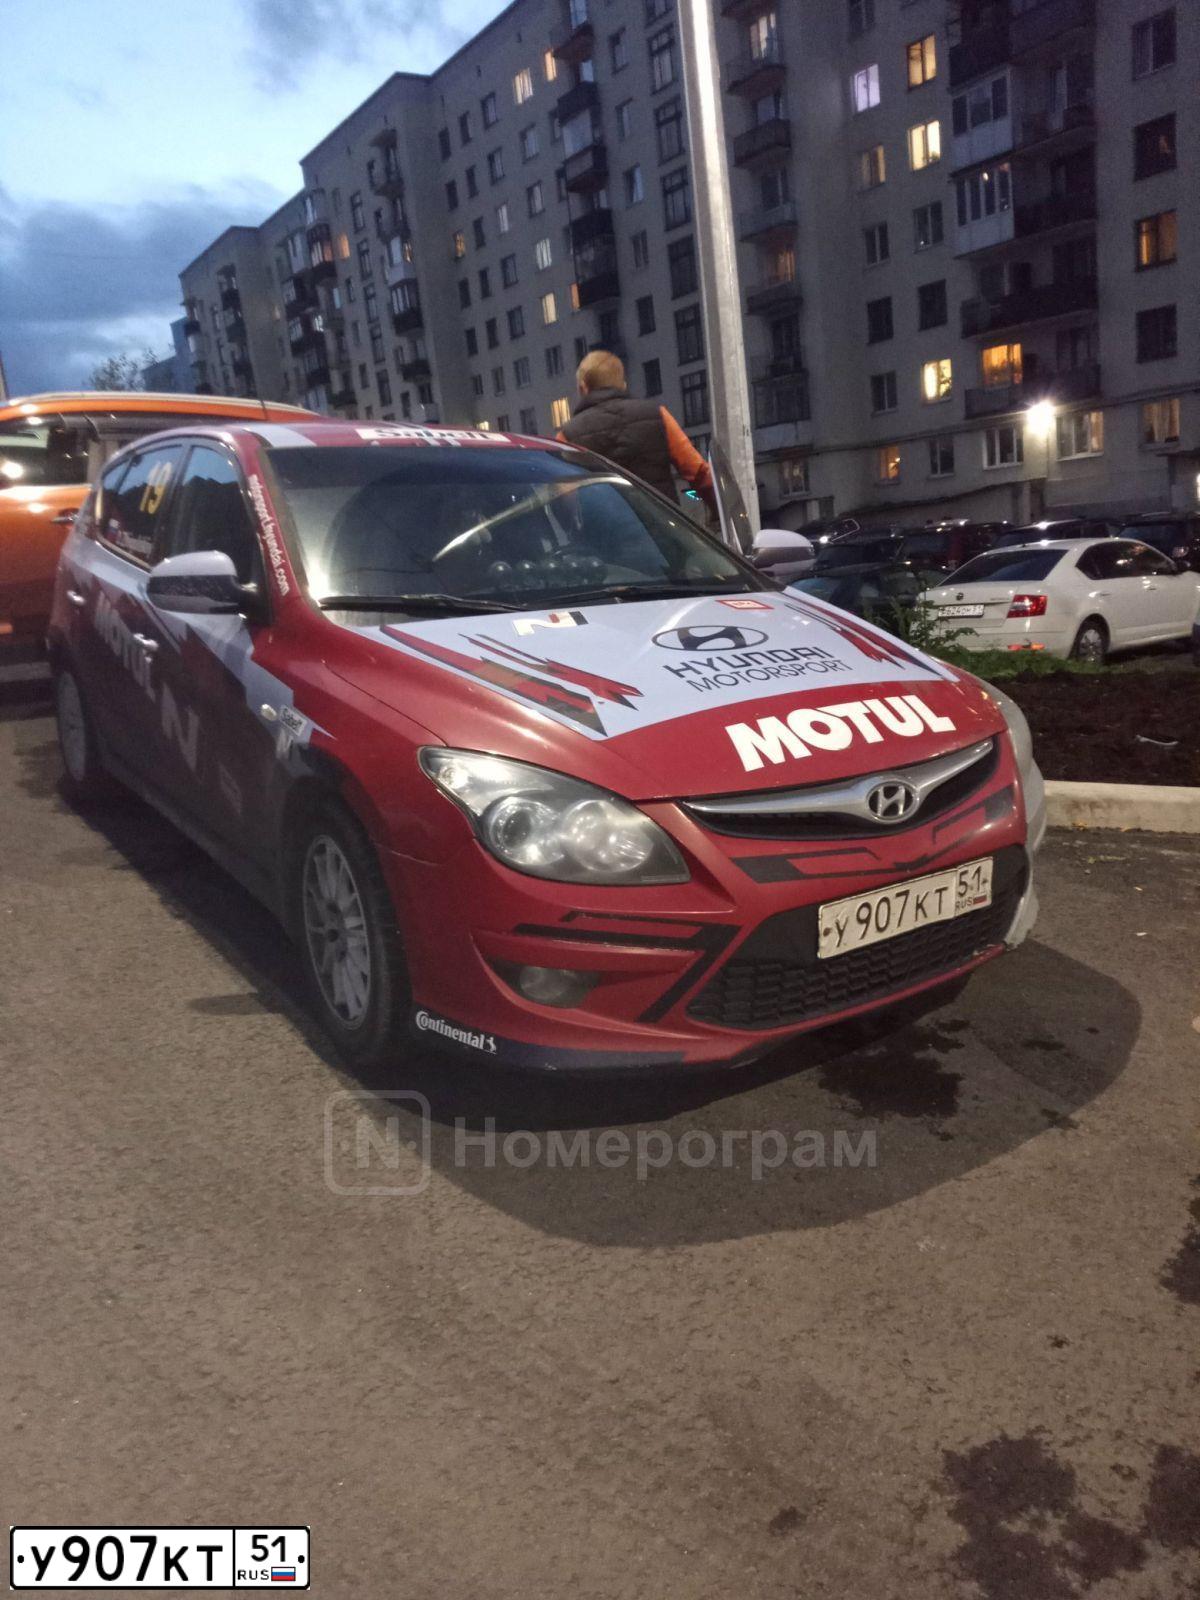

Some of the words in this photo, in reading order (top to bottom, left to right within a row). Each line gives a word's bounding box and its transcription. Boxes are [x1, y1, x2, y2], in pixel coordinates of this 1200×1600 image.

[663, 646, 834, 678] HYUNDAI
[686, 660, 854, 693] MOTORSPORT
[725, 694, 957, 772] MOTUL
[958, 865, 983, 898] 51
[955, 898, 974, 912] RUS
[416, 1010, 485, 1050] Continental
